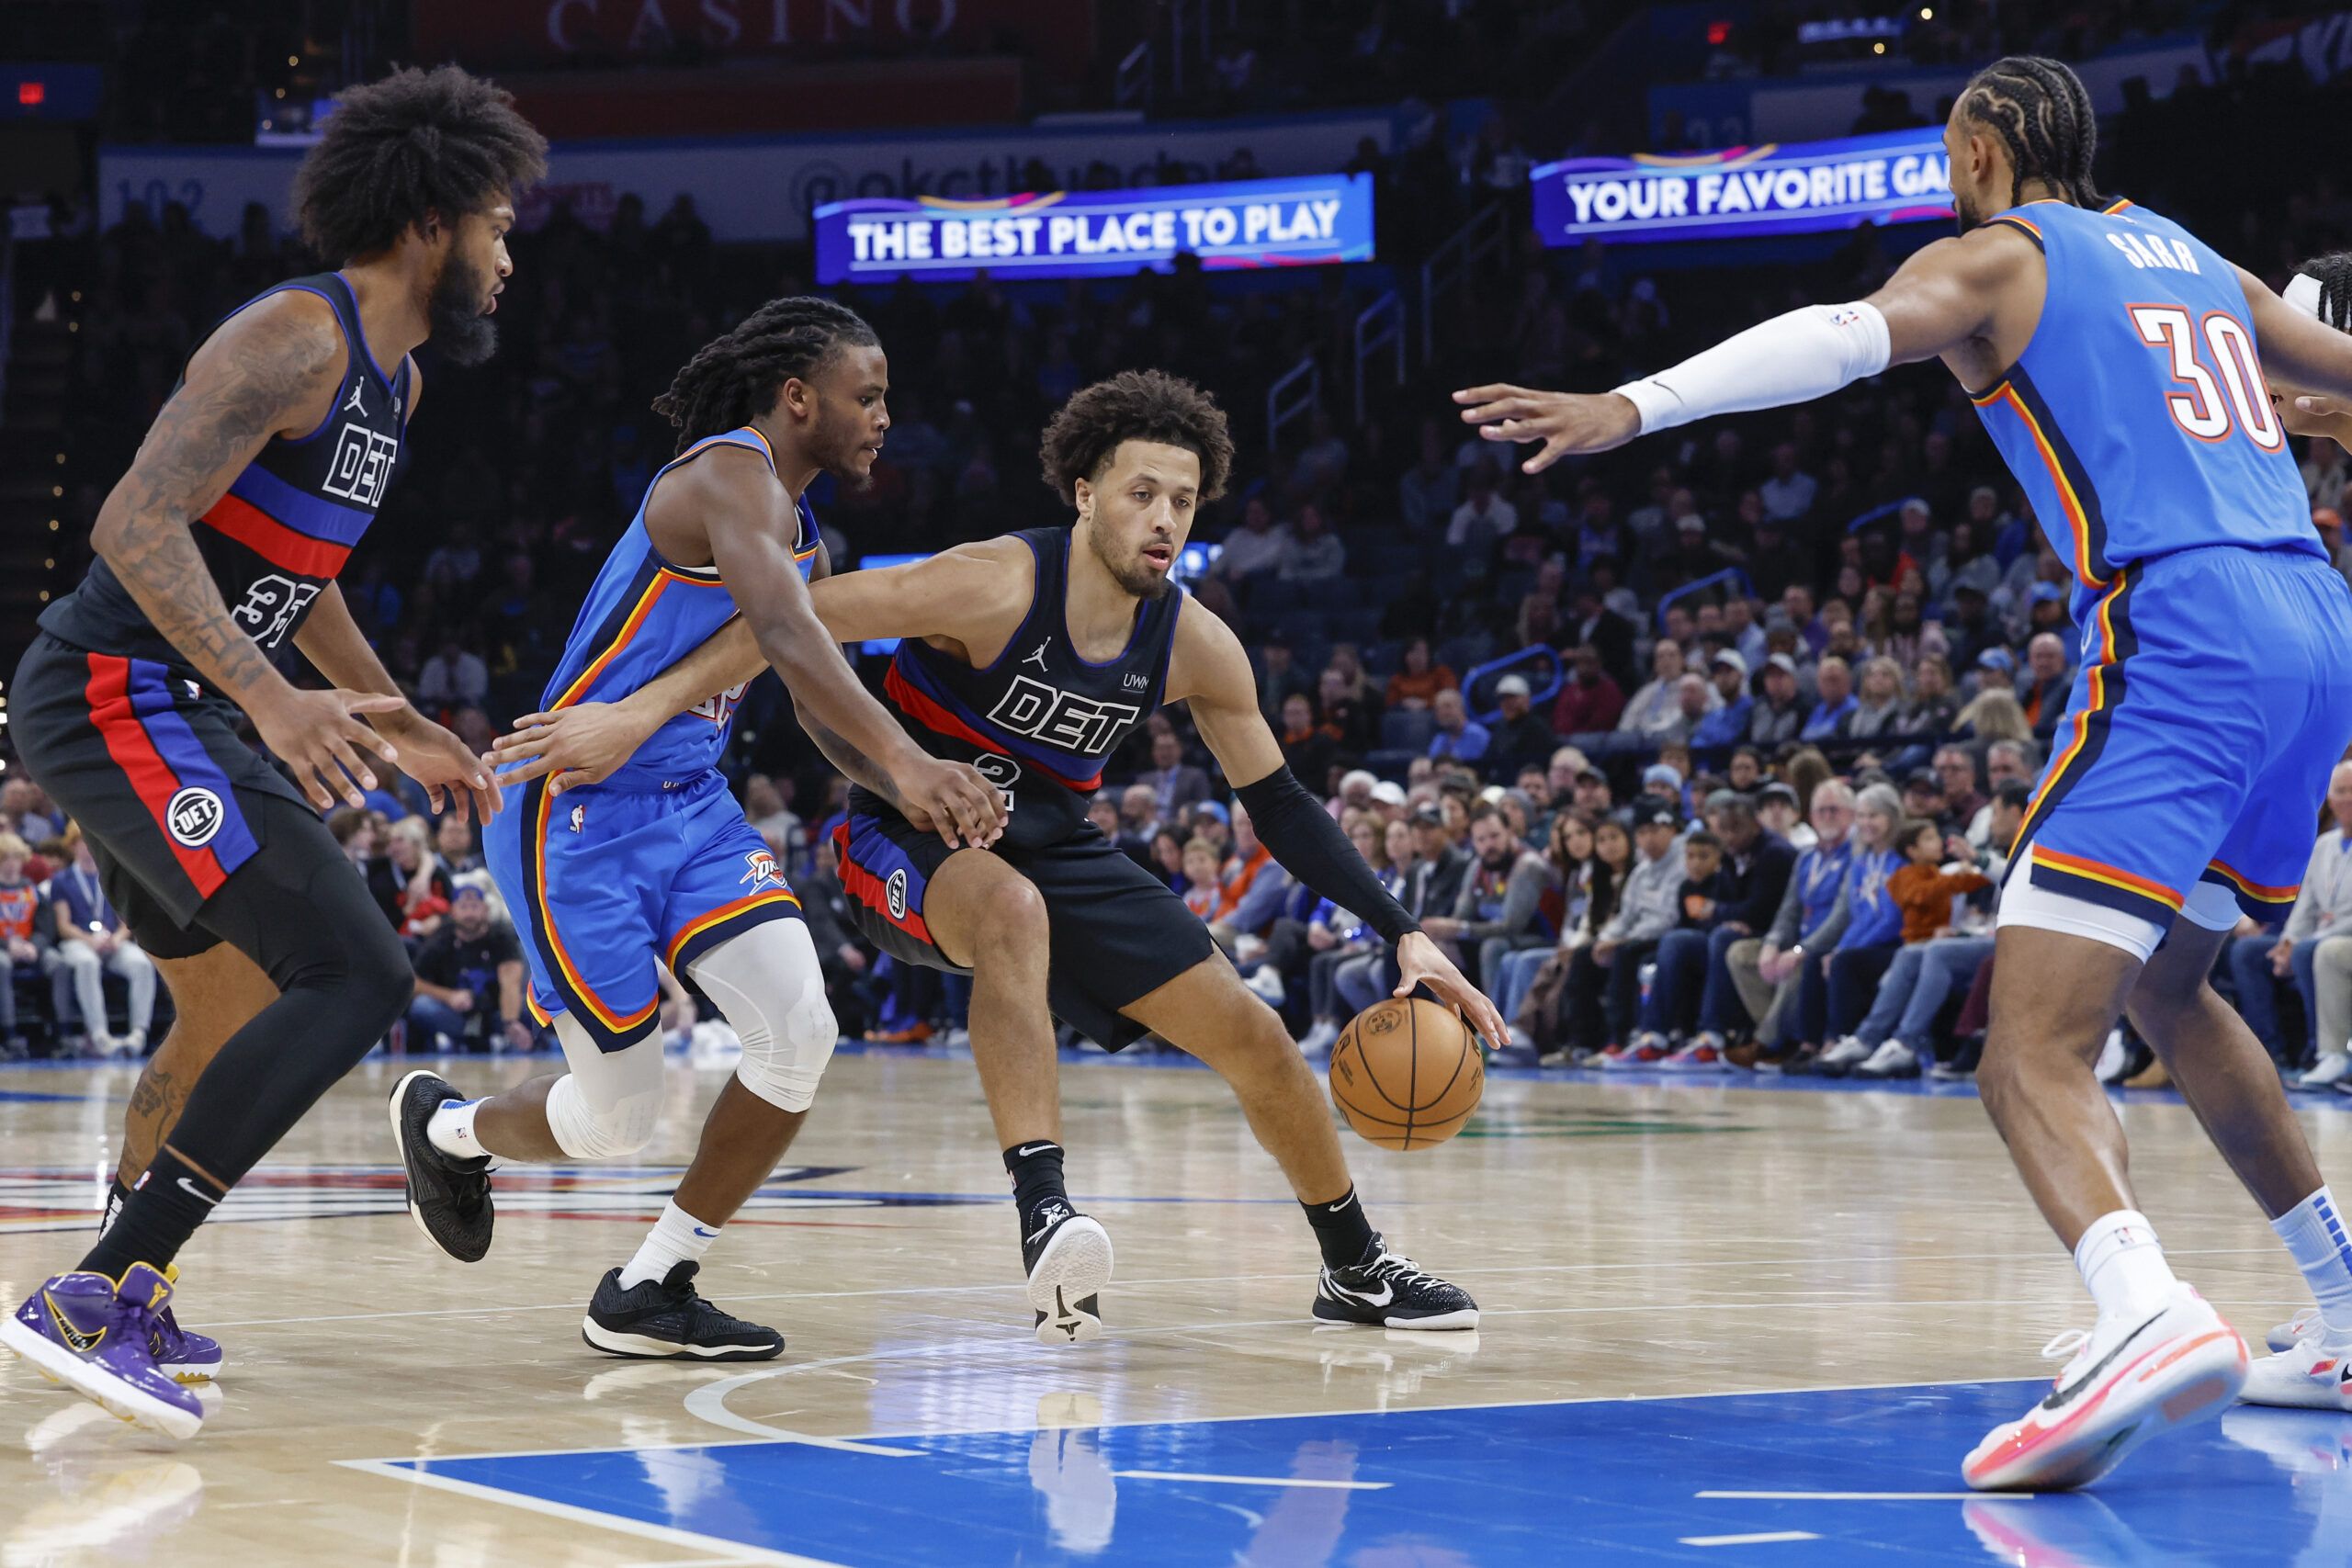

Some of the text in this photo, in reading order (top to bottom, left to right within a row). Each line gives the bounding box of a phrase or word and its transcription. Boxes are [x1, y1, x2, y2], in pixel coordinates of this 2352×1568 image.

[547, 0, 957, 51] CASINO
[1566, 153, 1953, 223] YOUR FAVORITE GA
[847, 198, 1341, 261] THE BEST PLACE TO PLAY
[2106, 231, 2200, 276] SARR
[2125, 303, 2285, 454] 30
[322, 423, 398, 508] DET
[986, 674, 1140, 754] DET
[175, 798, 214, 834] DET
[756, 859, 780, 882] OK
[891, 875, 902, 911] DET
